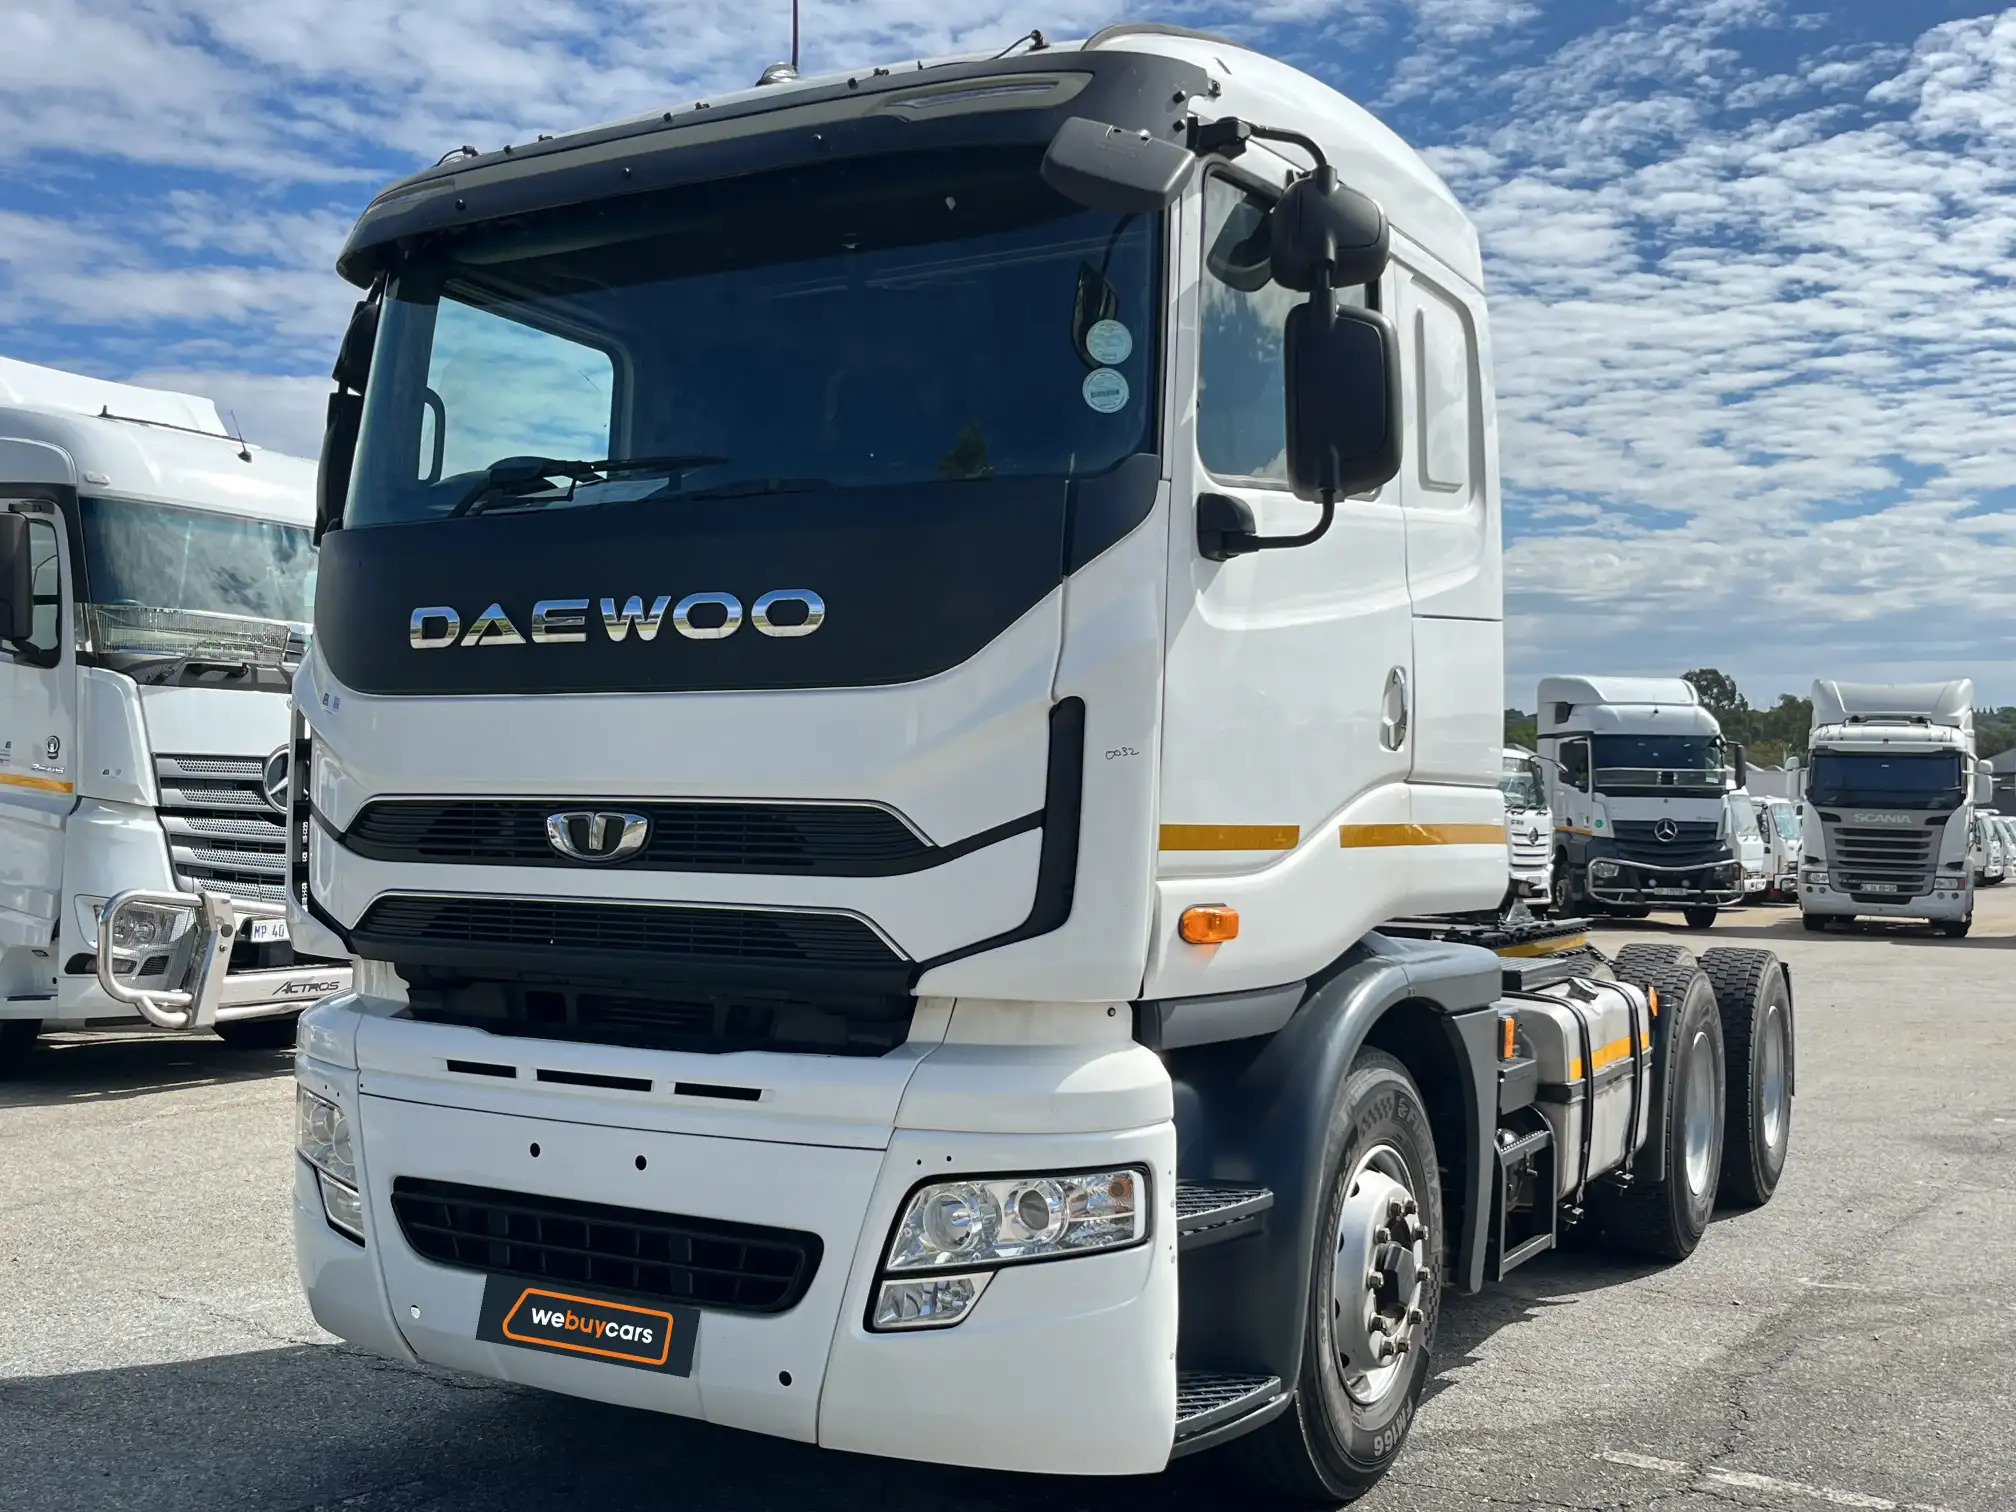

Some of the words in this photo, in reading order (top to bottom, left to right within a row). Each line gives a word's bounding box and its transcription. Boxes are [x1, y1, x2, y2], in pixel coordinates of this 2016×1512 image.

[410, 588, 826, 649] DAEWOO
[1105, 746, 1140, 760] 0032
[1853, 813, 1912, 824] SCANIA
[253, 925, 267, 939] MP
[272, 924, 285, 937] 40
[272, 980, 340, 996] ACTROS
[1373, 1395, 1413, 1457] FM166
